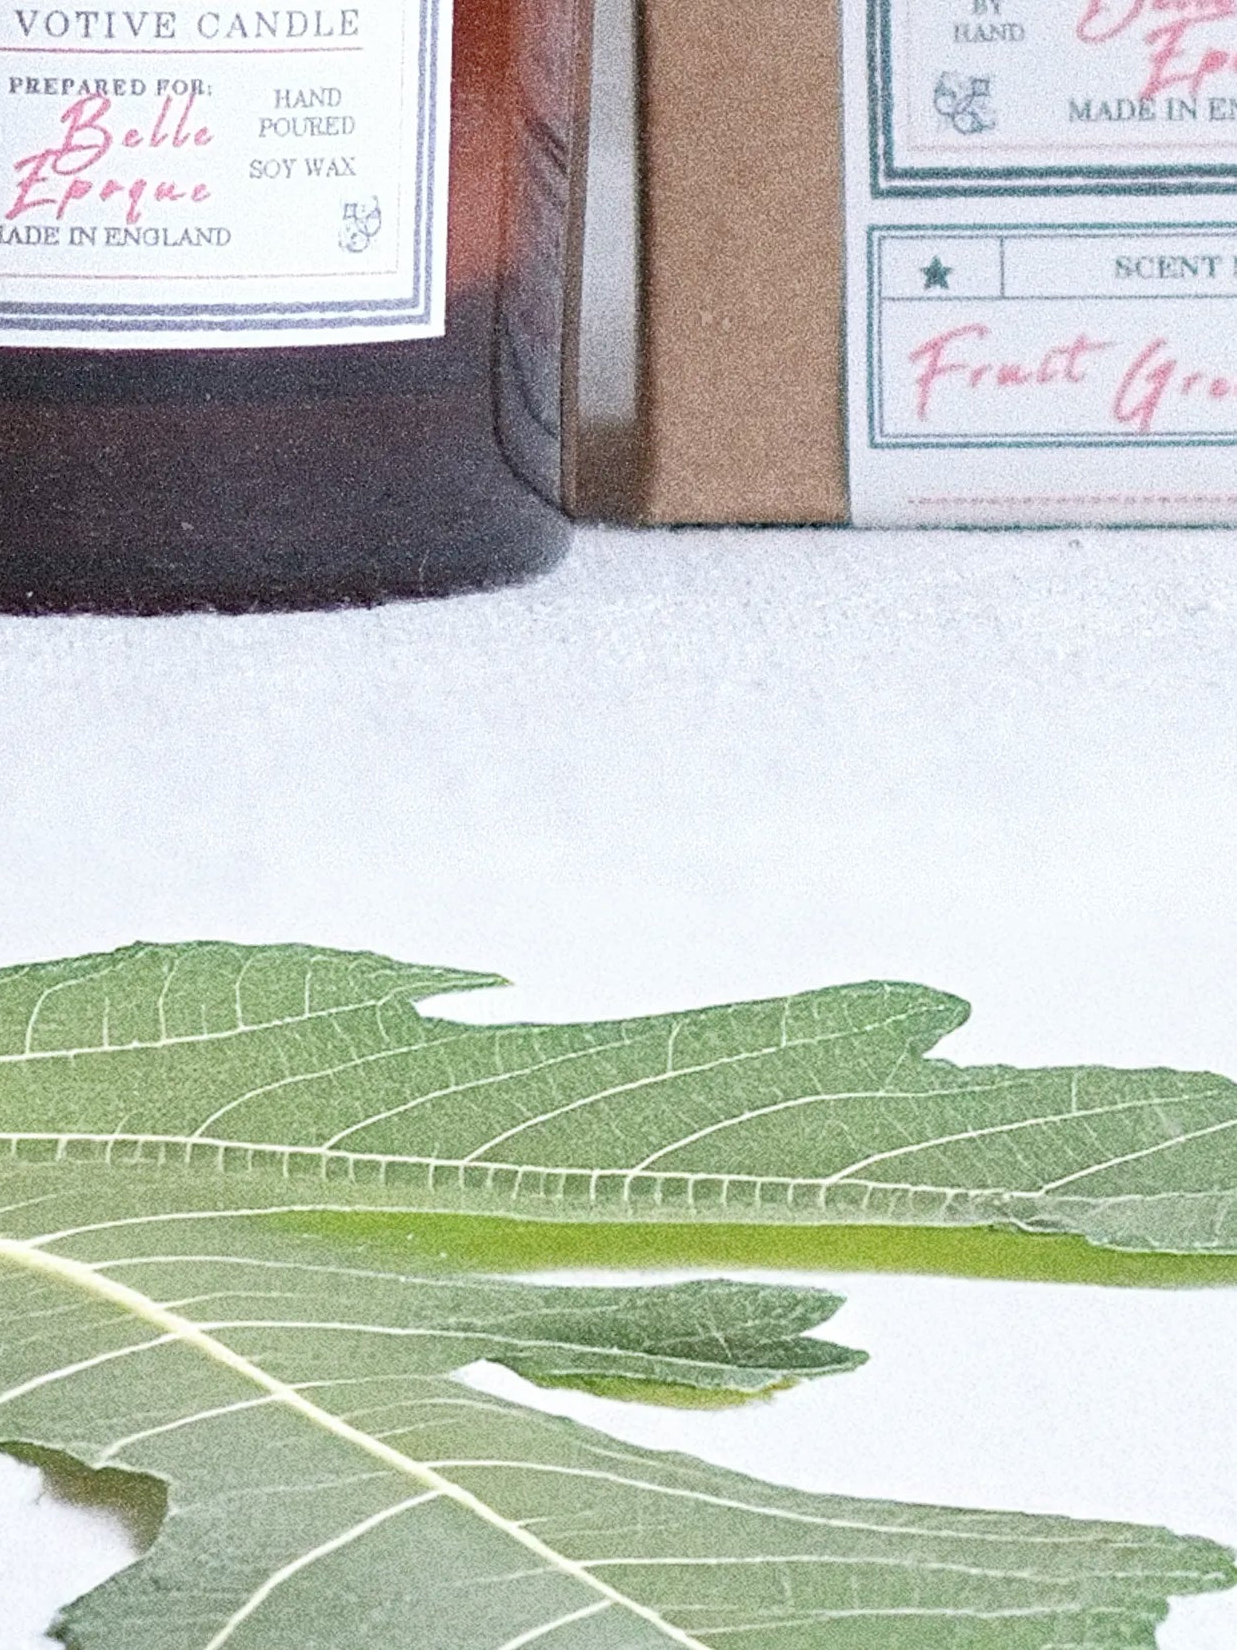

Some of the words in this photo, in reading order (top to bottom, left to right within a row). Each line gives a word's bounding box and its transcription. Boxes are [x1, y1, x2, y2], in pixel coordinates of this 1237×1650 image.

[15, 8, 177, 40] VOTIVE
[196, 8, 359, 40] CANDLE
[953, 22, 1026, 44] HAND
[7, 75, 148, 98] PREPARED
[274, 86, 343, 110] HAND
[1068, 96, 1156, 123] MADE
[1166, 96, 1198, 121] IN
[51, 92, 214, 176] Belle
[258, 115, 356, 139] POURED
[248, 157, 297, 180] SOY
[304, 156, 356, 178] WAX
[68, 226, 98, 246] IN
[103, 226, 232, 248] ENGLAND
[1115, 255, 1221, 279] SCENT
